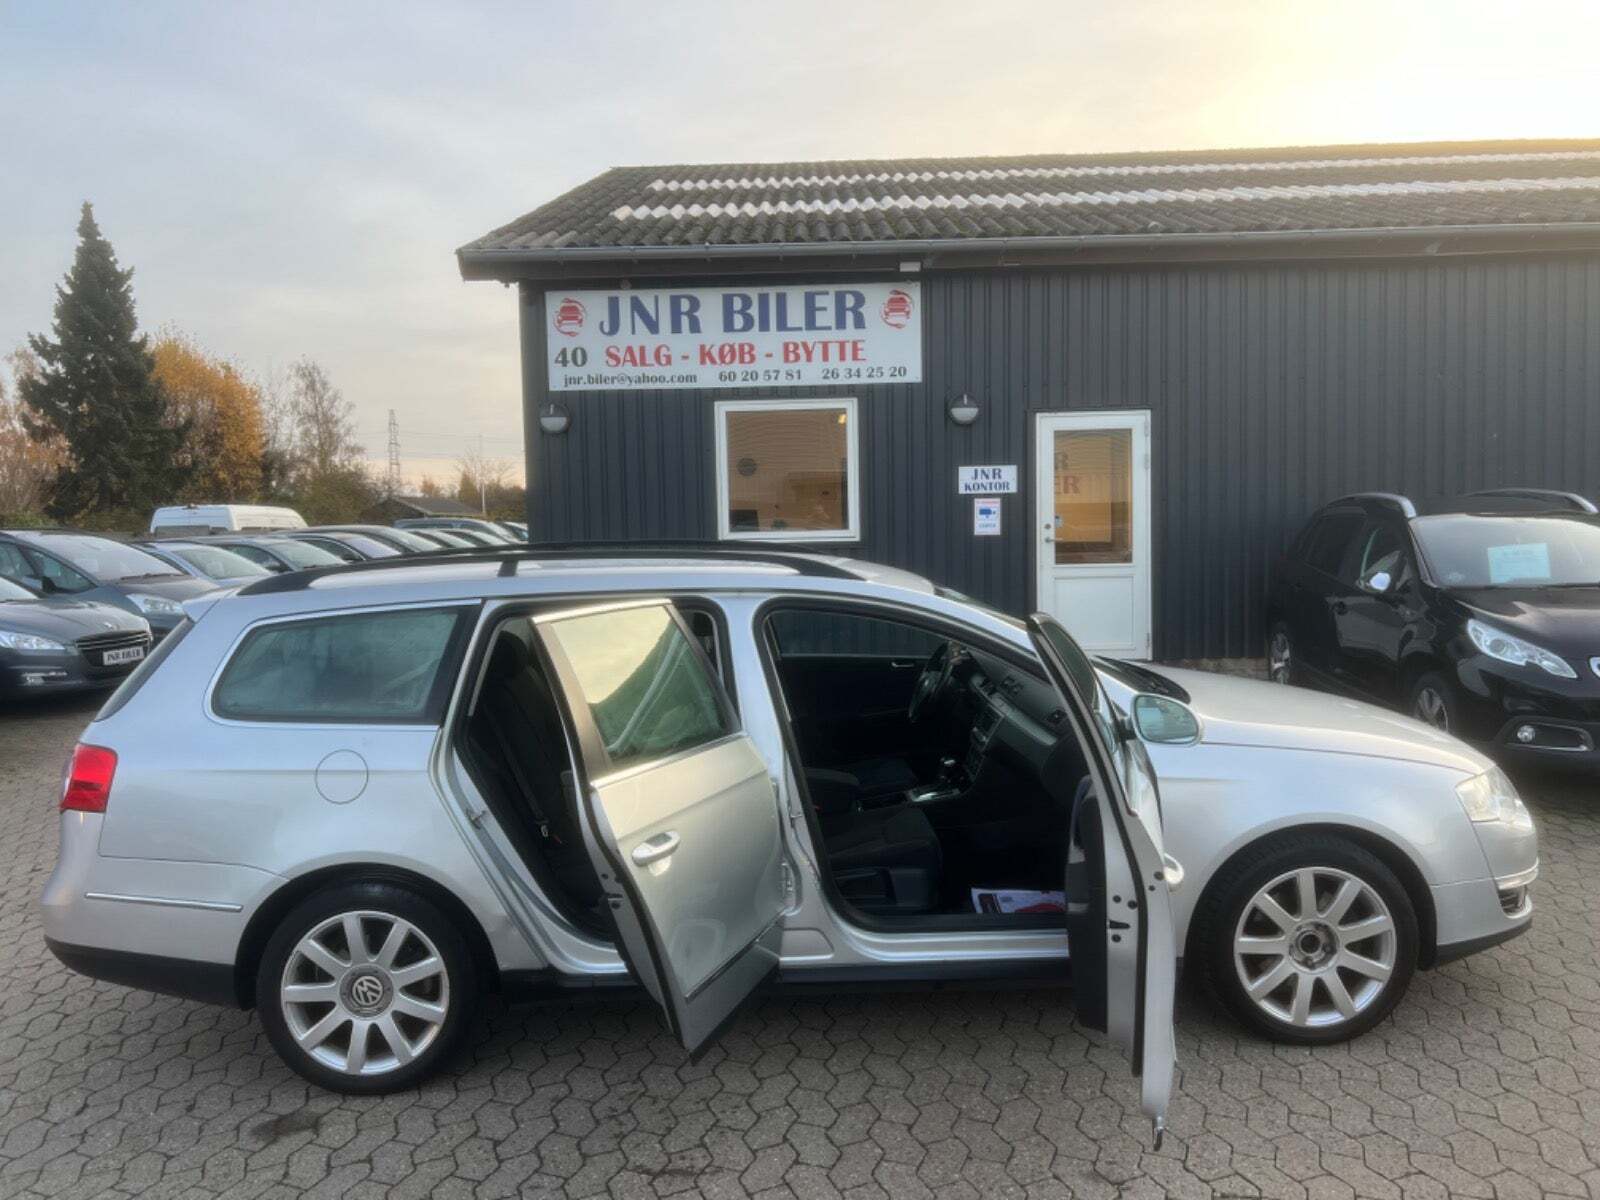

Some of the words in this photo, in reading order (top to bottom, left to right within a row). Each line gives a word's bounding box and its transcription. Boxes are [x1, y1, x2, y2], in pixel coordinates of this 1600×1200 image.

[600, 294, 702, 336] JNR
[722, 290, 866, 333] BILER
[554, 346, 588, 368] 40
[605, 343, 672, 368] SALG
[699, 342, 756, 367] KØB
[783, 339, 867, 364] BYTTE
[718, 371, 737, 383] 60
[741, 370, 759, 382] 20
[763, 369, 781, 381] 57
[785, 369, 801, 381] 81
[822, 368, 840, 380] 26
[844, 368, 861, 379] 34
[866, 366, 884, 379] 25
[889, 365, 907, 378] 20
[564, 373, 698, 388] jnr.biler@yahoo.com
[971, 468, 1003, 480] JNR
[964, 481, 1010, 492] KONTOR
